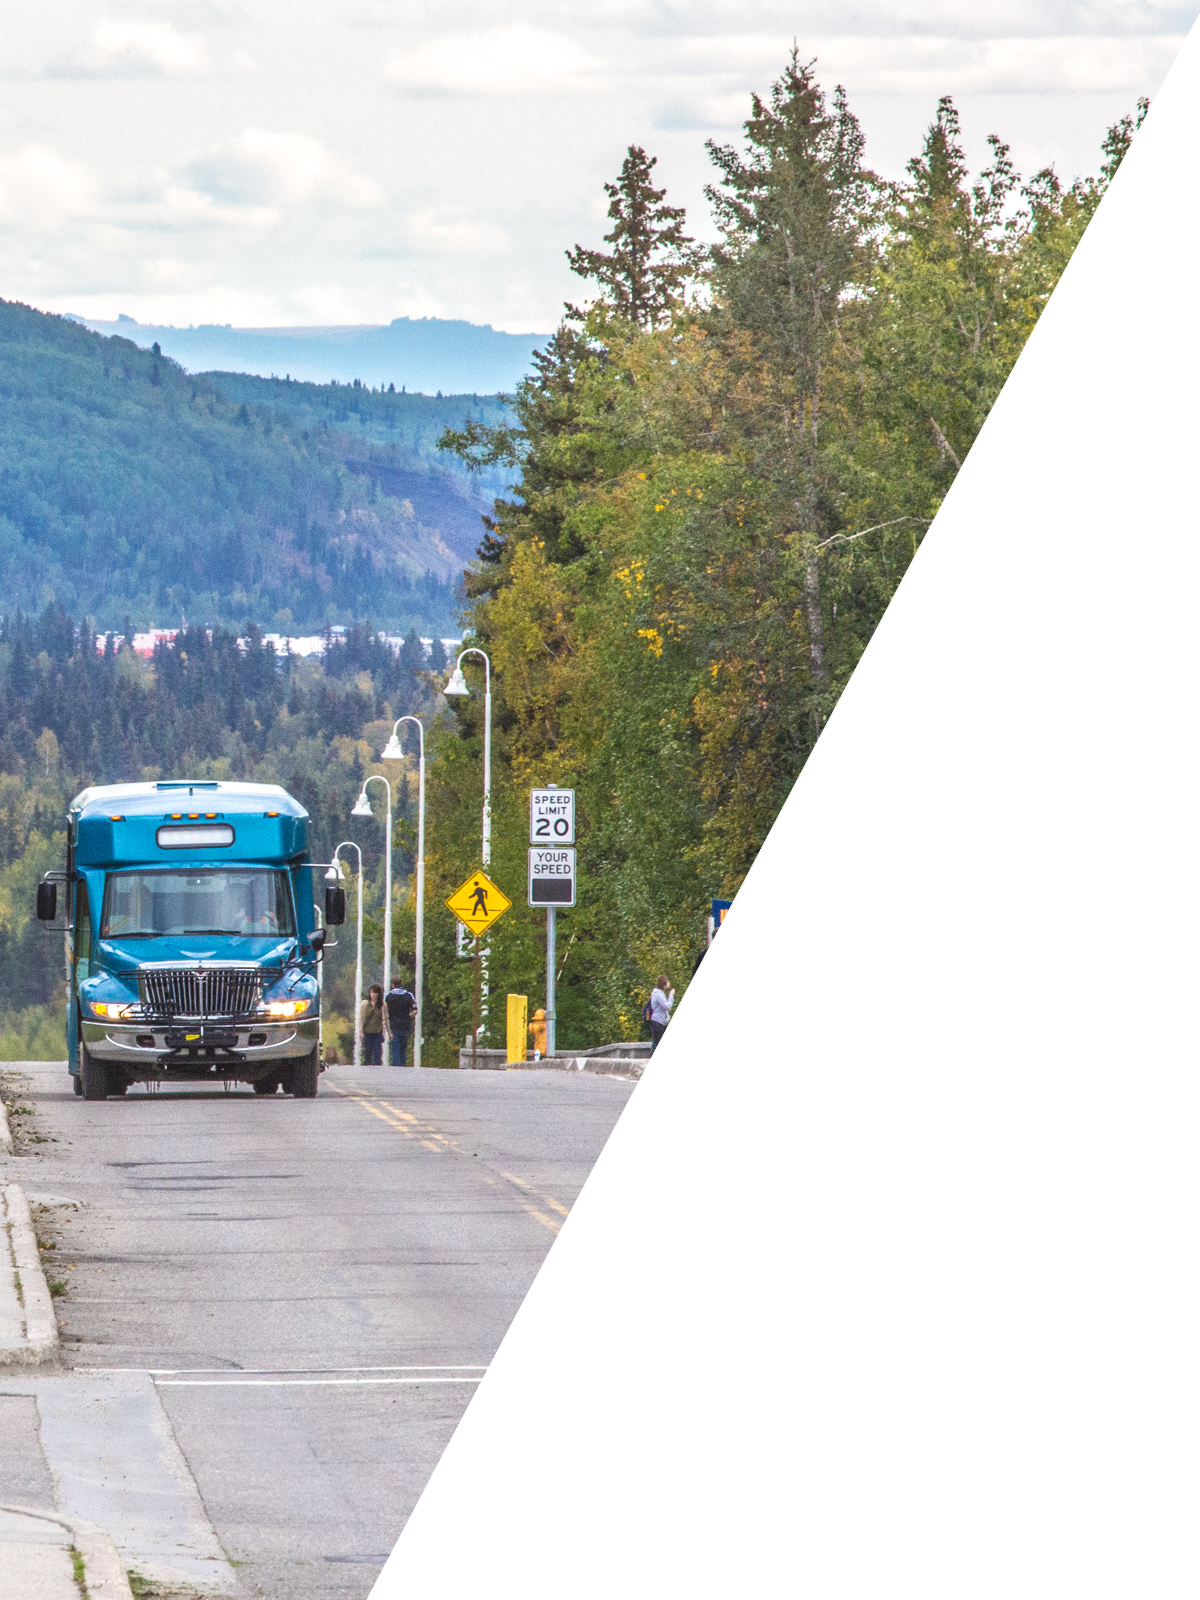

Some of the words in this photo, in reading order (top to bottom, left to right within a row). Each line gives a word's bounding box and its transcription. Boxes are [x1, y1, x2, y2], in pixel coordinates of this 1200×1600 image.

[534, 795, 571, 804] SPEED
[538, 806, 567, 815] LIMIT
[535, 818, 569, 836] 20
[536, 852, 568, 862] YOUR
[533, 864, 571, 875] SPEED
[756, 926, 782, 934] CAMPUS
[757, 1180, 780, 1190] YIELD
[765, 1189, 776, 1198] TO
[773, 1283, 784, 1292] IN
[752, 1294, 807, 1308] CROSSWALK
